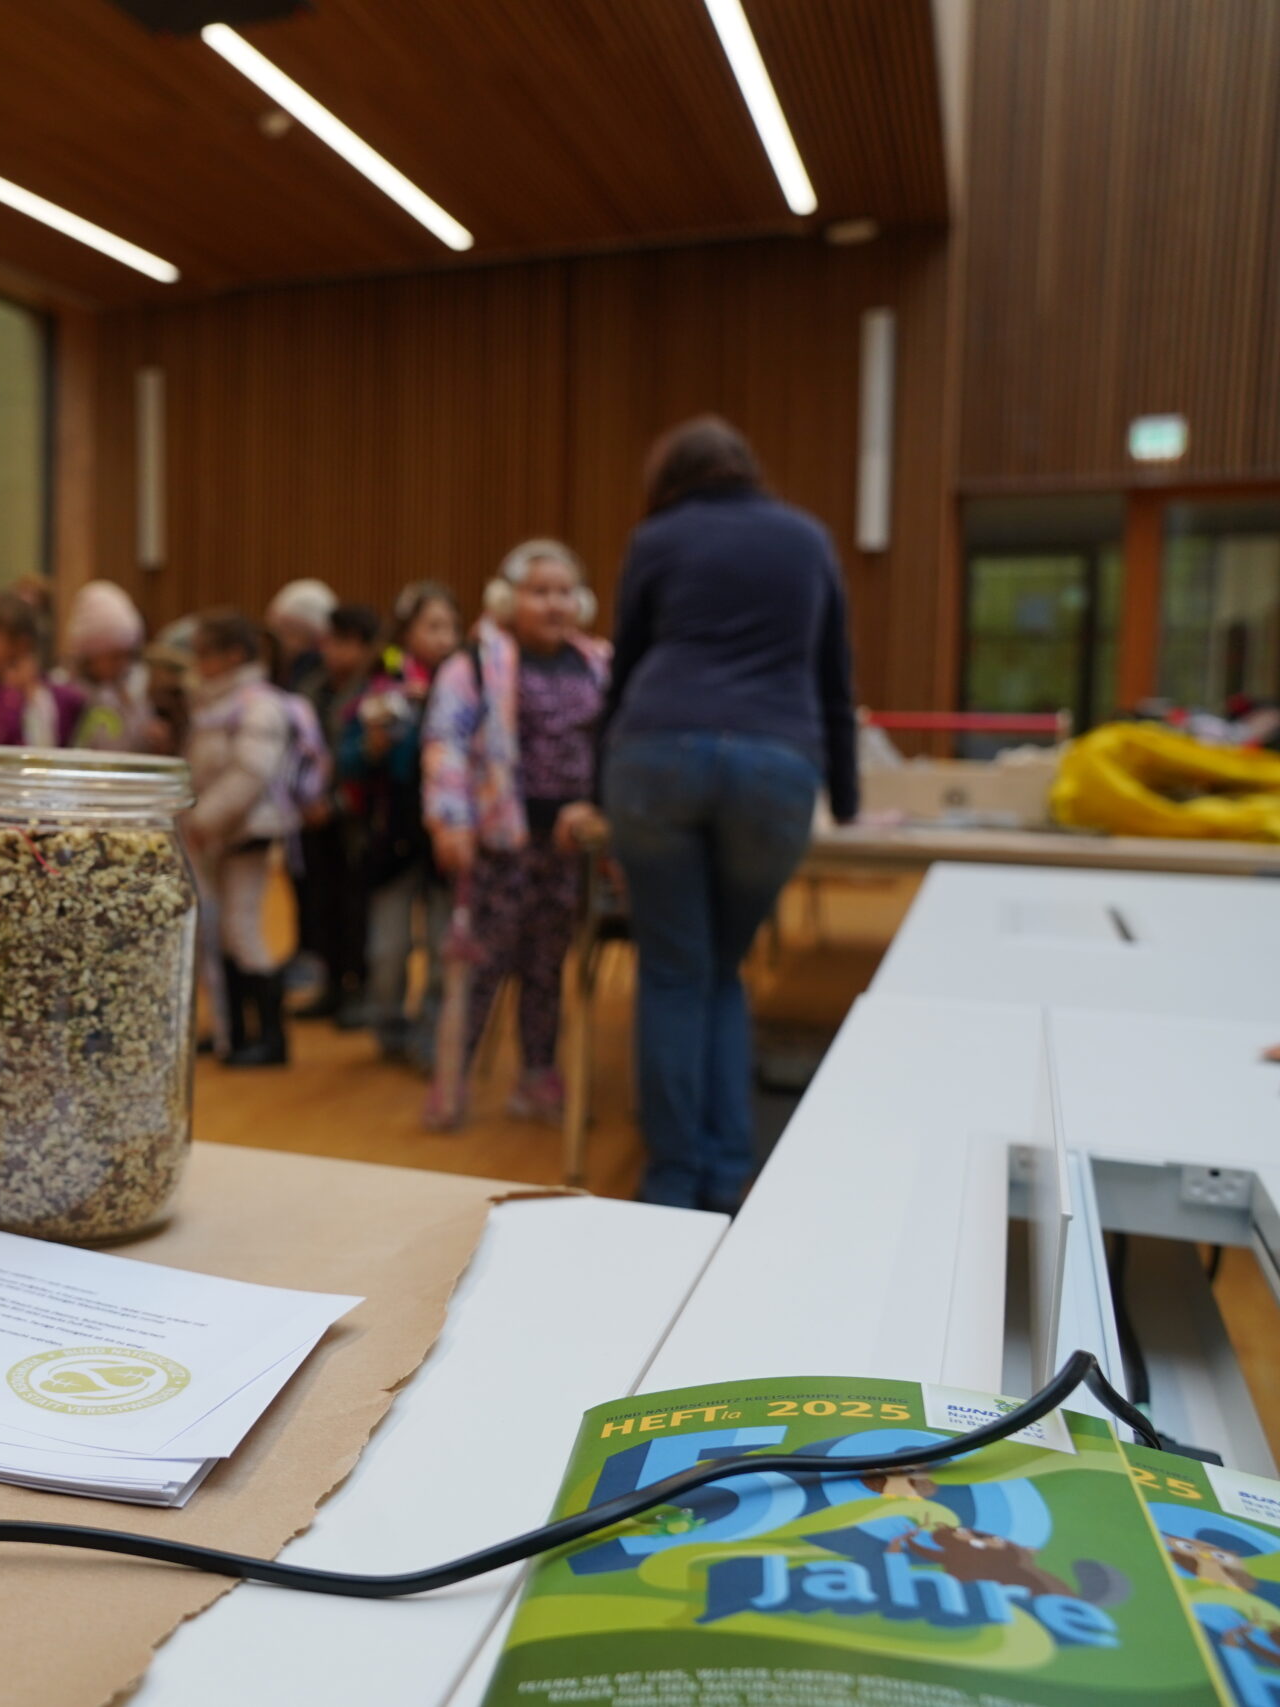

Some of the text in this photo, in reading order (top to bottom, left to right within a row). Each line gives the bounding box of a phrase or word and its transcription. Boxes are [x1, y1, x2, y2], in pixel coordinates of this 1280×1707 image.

[22, 1391, 65, 1410] STATT
[599, 1405, 729, 1440] HEFT
[766, 1399, 912, 1421] 2025
[645, 1396, 742, 1416] NATURSCHUTZ
[600, 1425, 1053, 1560] 50
[750, 1551, 1120, 1649] Jahre
